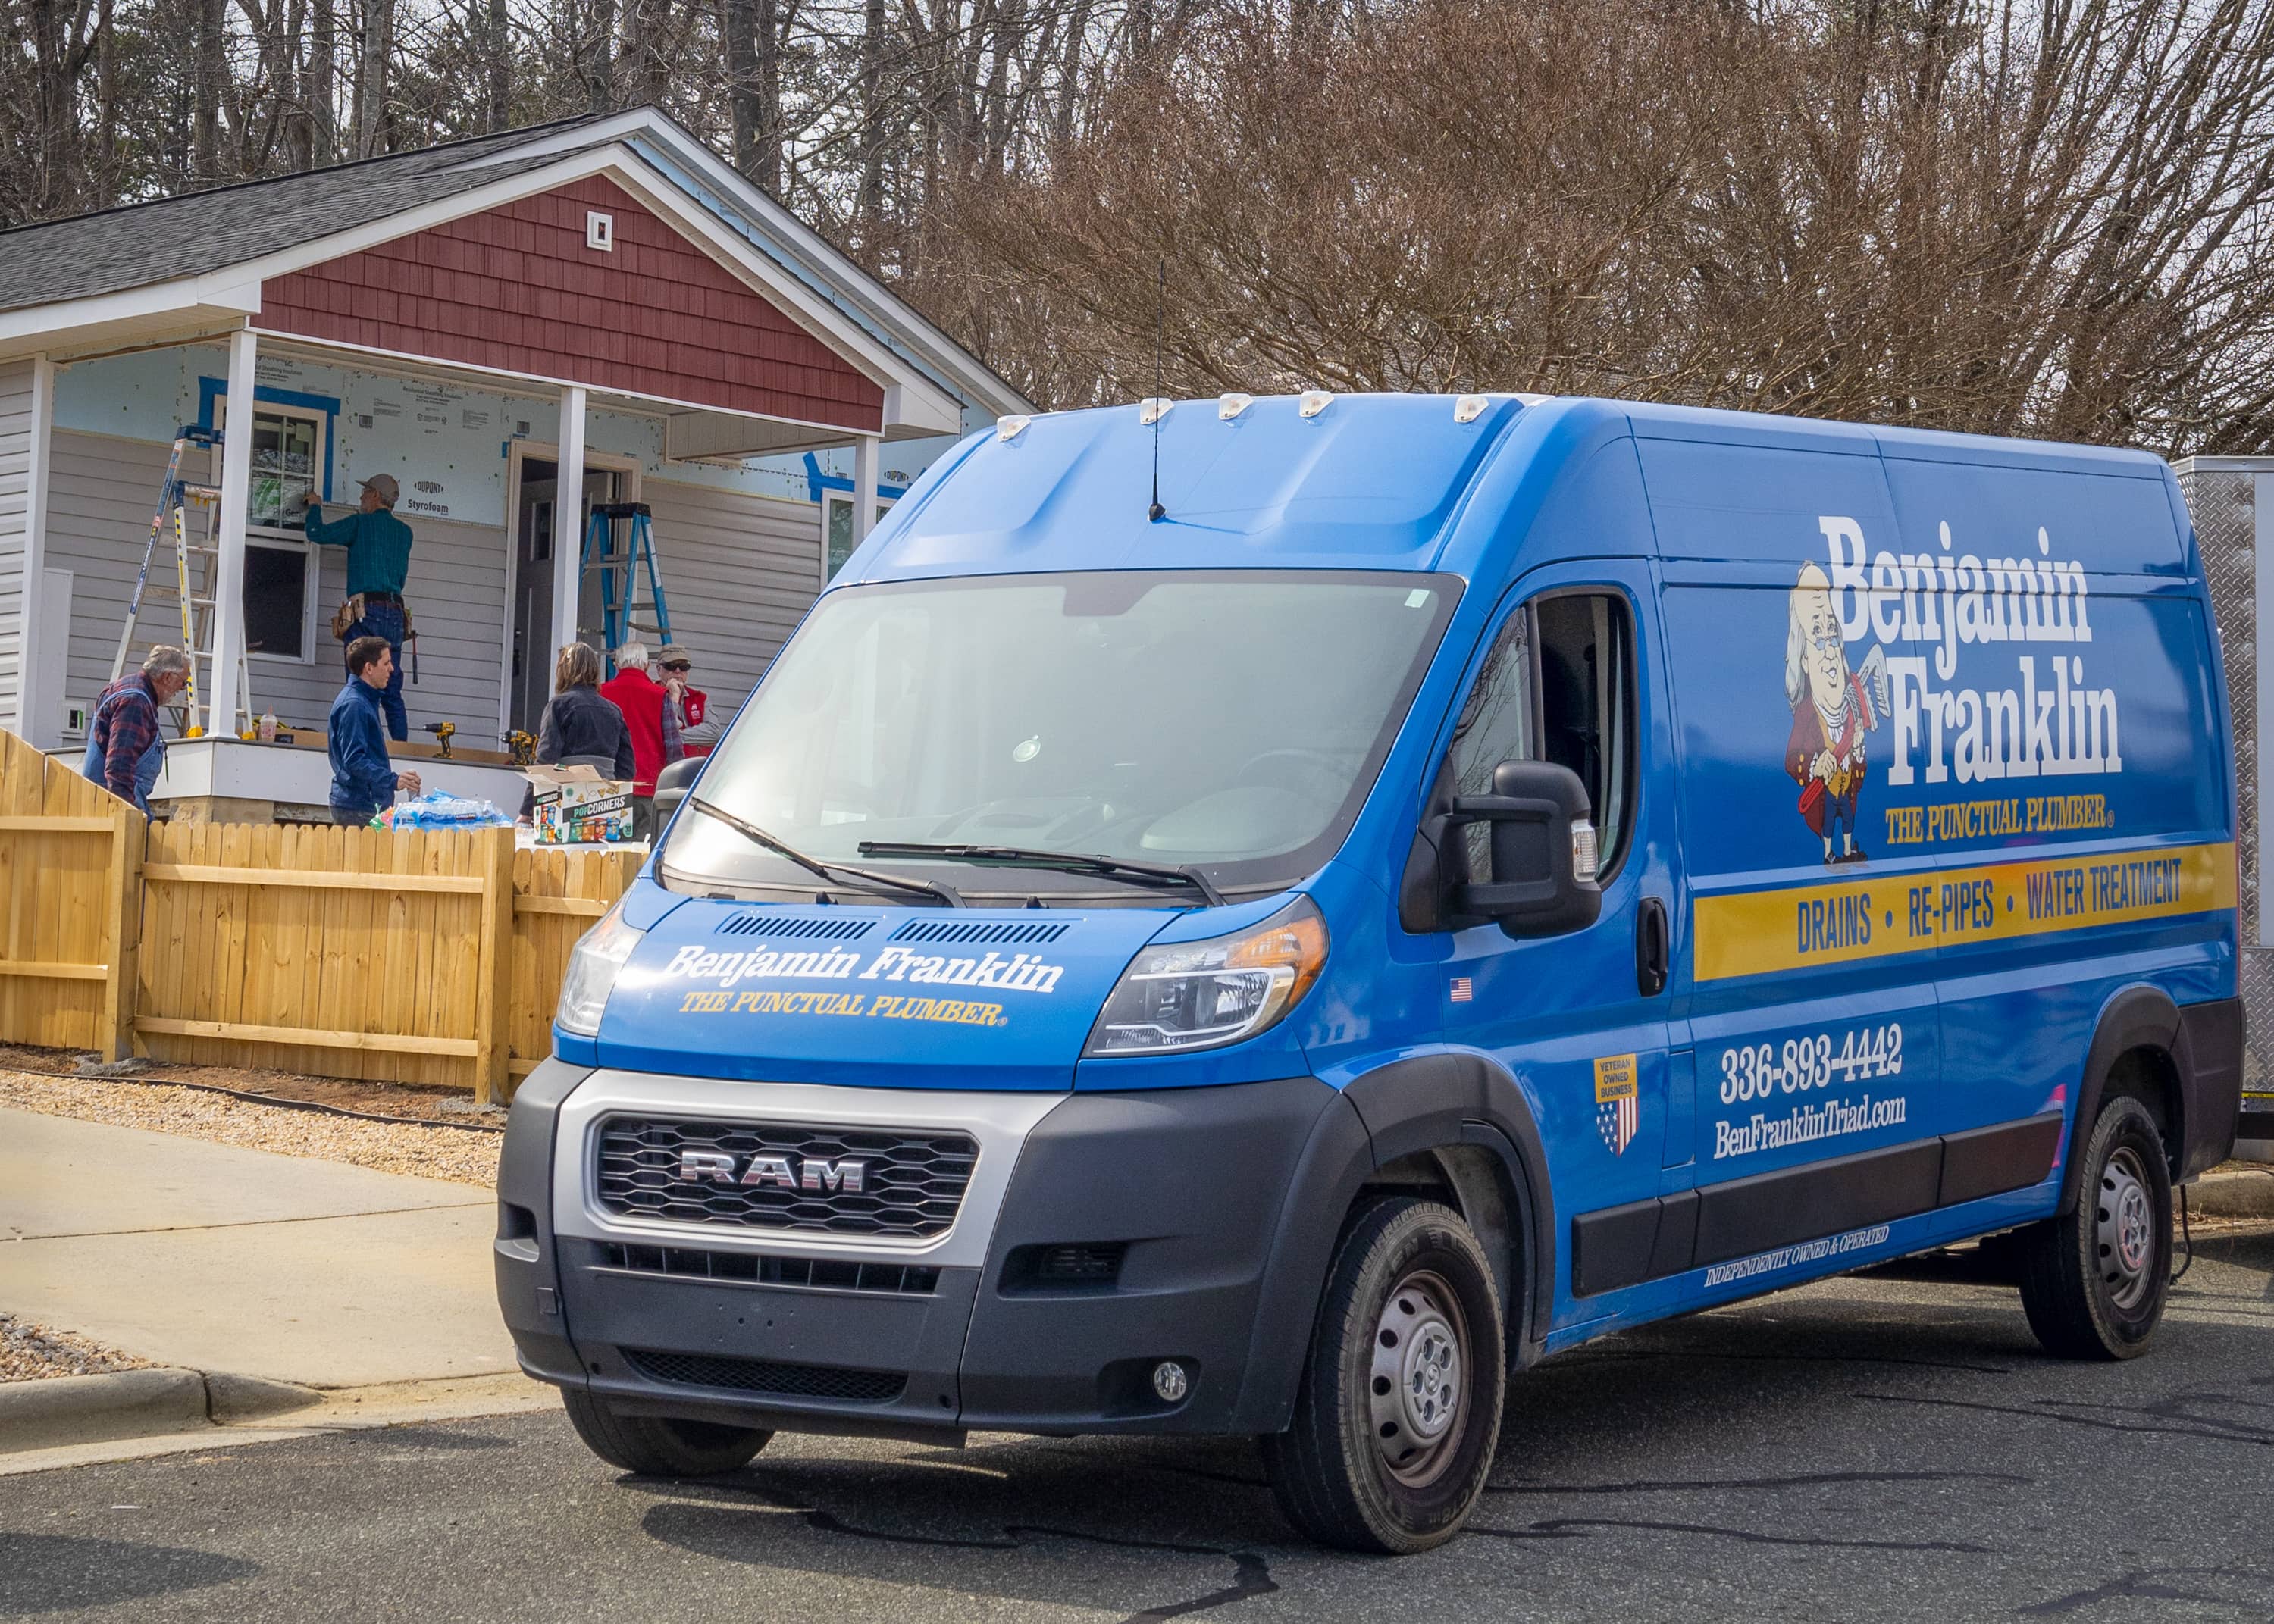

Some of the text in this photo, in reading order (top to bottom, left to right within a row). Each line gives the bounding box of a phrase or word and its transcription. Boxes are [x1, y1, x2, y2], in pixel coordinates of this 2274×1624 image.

[408, 499, 449, 513] Styrofoam
[417, 480, 441, 494] DUPONT
[1819, 516, 2092, 681] Benjamin
[1887, 656, 2122, 785] Franklin
[574, 796, 625, 818] POPCORNERS
[1886, 806, 1924, 844] THE
[1926, 799, 2022, 842] PUNCTUAL
[1798, 858, 2182, 953] DRAINS RE-PIPES WATER TREATMENT
[662, 944, 1064, 994] Benjamin Franklin
[679, 991, 735, 1013] THE
[730, 992, 866, 1016] PUNCTUAL
[1599, 1059, 1631, 1072] VETERAN
[1603, 1071, 1629, 1084] OWNED
[1721, 1023, 1902, 1104] 336-893-4442
[1600, 1084, 1633, 1098] BUSINESS
[1714, 1094, 1906, 1159] BenFranklinTriad.com
[681, 1150, 866, 1192] RAM
[1704, 1225, 1890, 1288] INDEPENDENTLY OWNED & OPERATED
